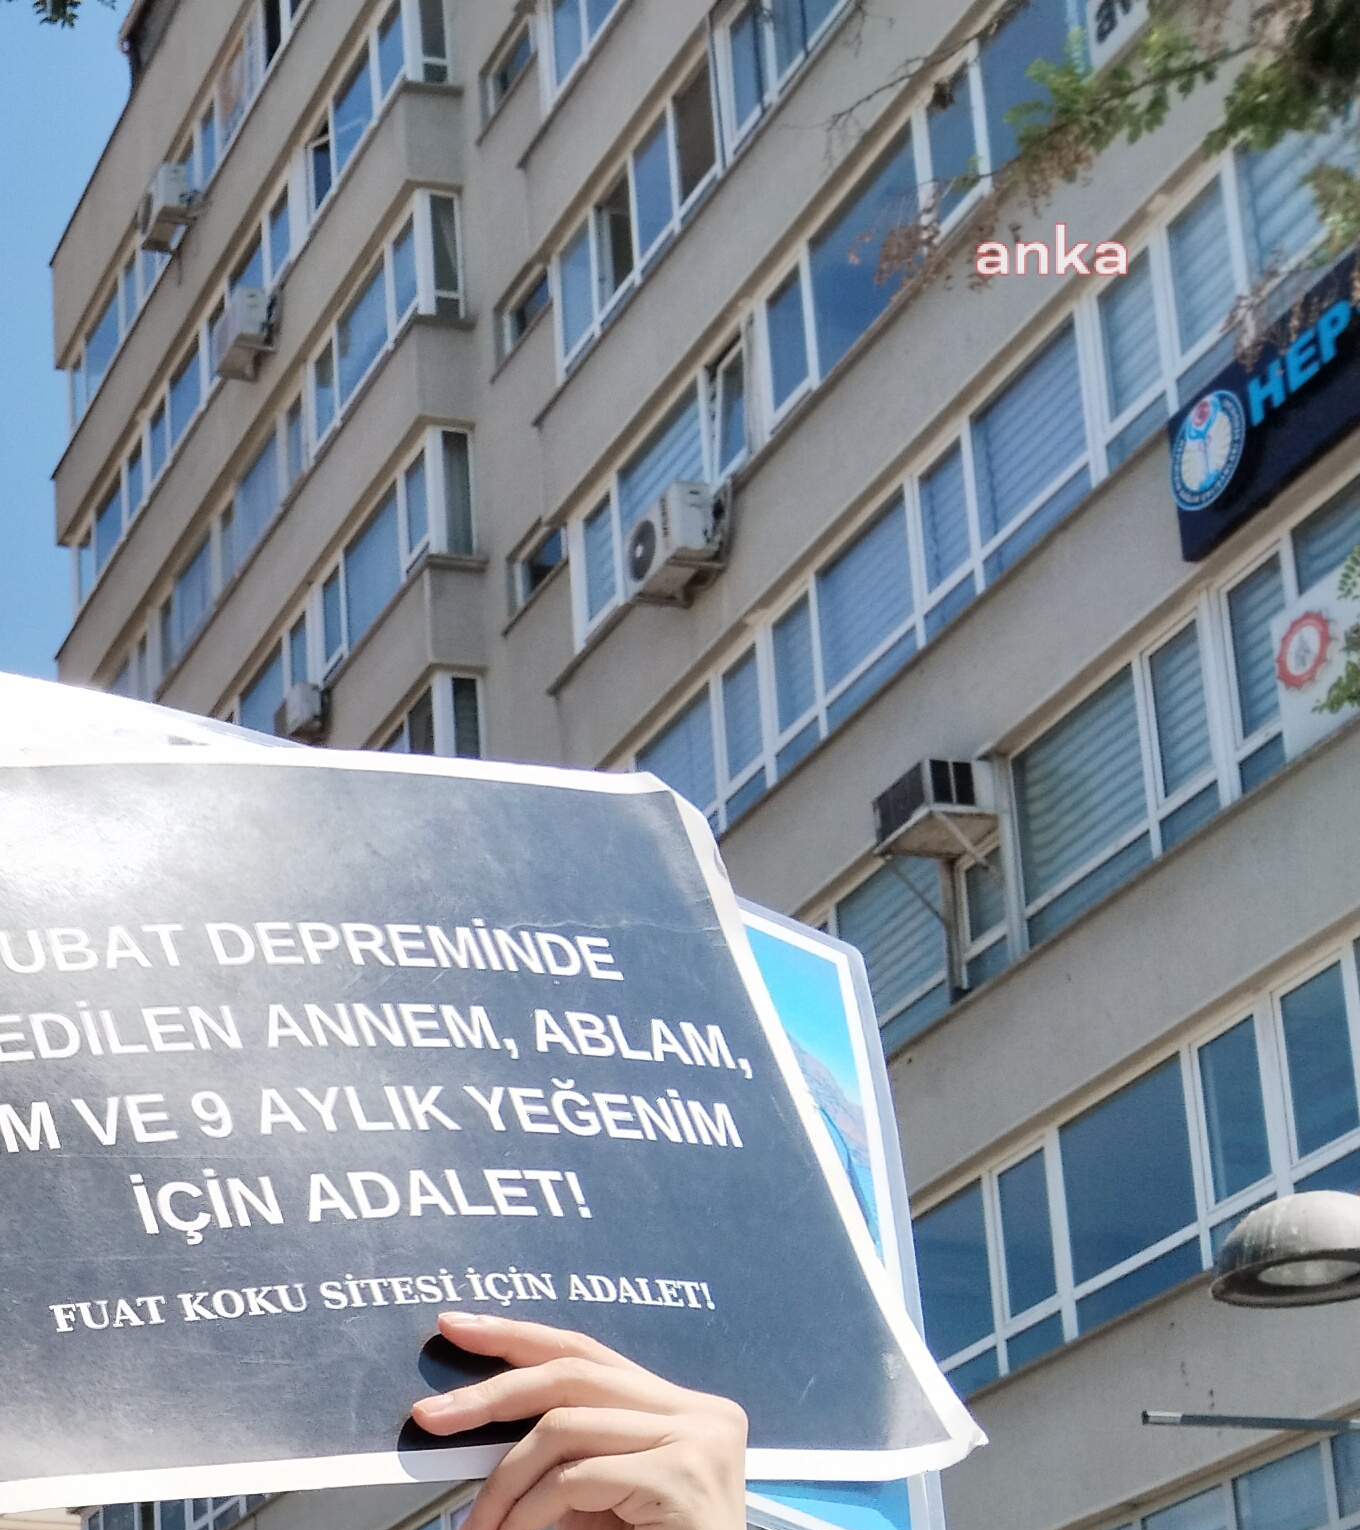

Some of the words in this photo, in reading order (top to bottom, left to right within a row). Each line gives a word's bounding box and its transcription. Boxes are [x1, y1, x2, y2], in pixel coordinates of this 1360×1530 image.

[1247, 298, 1360, 427] HEP
[205, 918, 625, 981] DEPREMİNDE
[267, 1002, 521, 1060] ANNEM,
[535, 1008, 754, 1080] ABLAM,
[72, 1093, 179, 1146] VE
[191, 1090, 234, 1139] 9
[260, 1084, 462, 1136] AYLIK
[463, 1078, 745, 1149] YEĞENİM
[129, 1170, 285, 1246] İÇİN
[307, 1169, 594, 1223] ADALET!
[49, 1295, 167, 1334] FUAT
[177, 1283, 308, 1324] KOKU
[322, 1267, 455, 1312] SİTESİ
[466, 1266, 559, 1309] İÇİN
[569, 1273, 716, 1311] ADALET!
